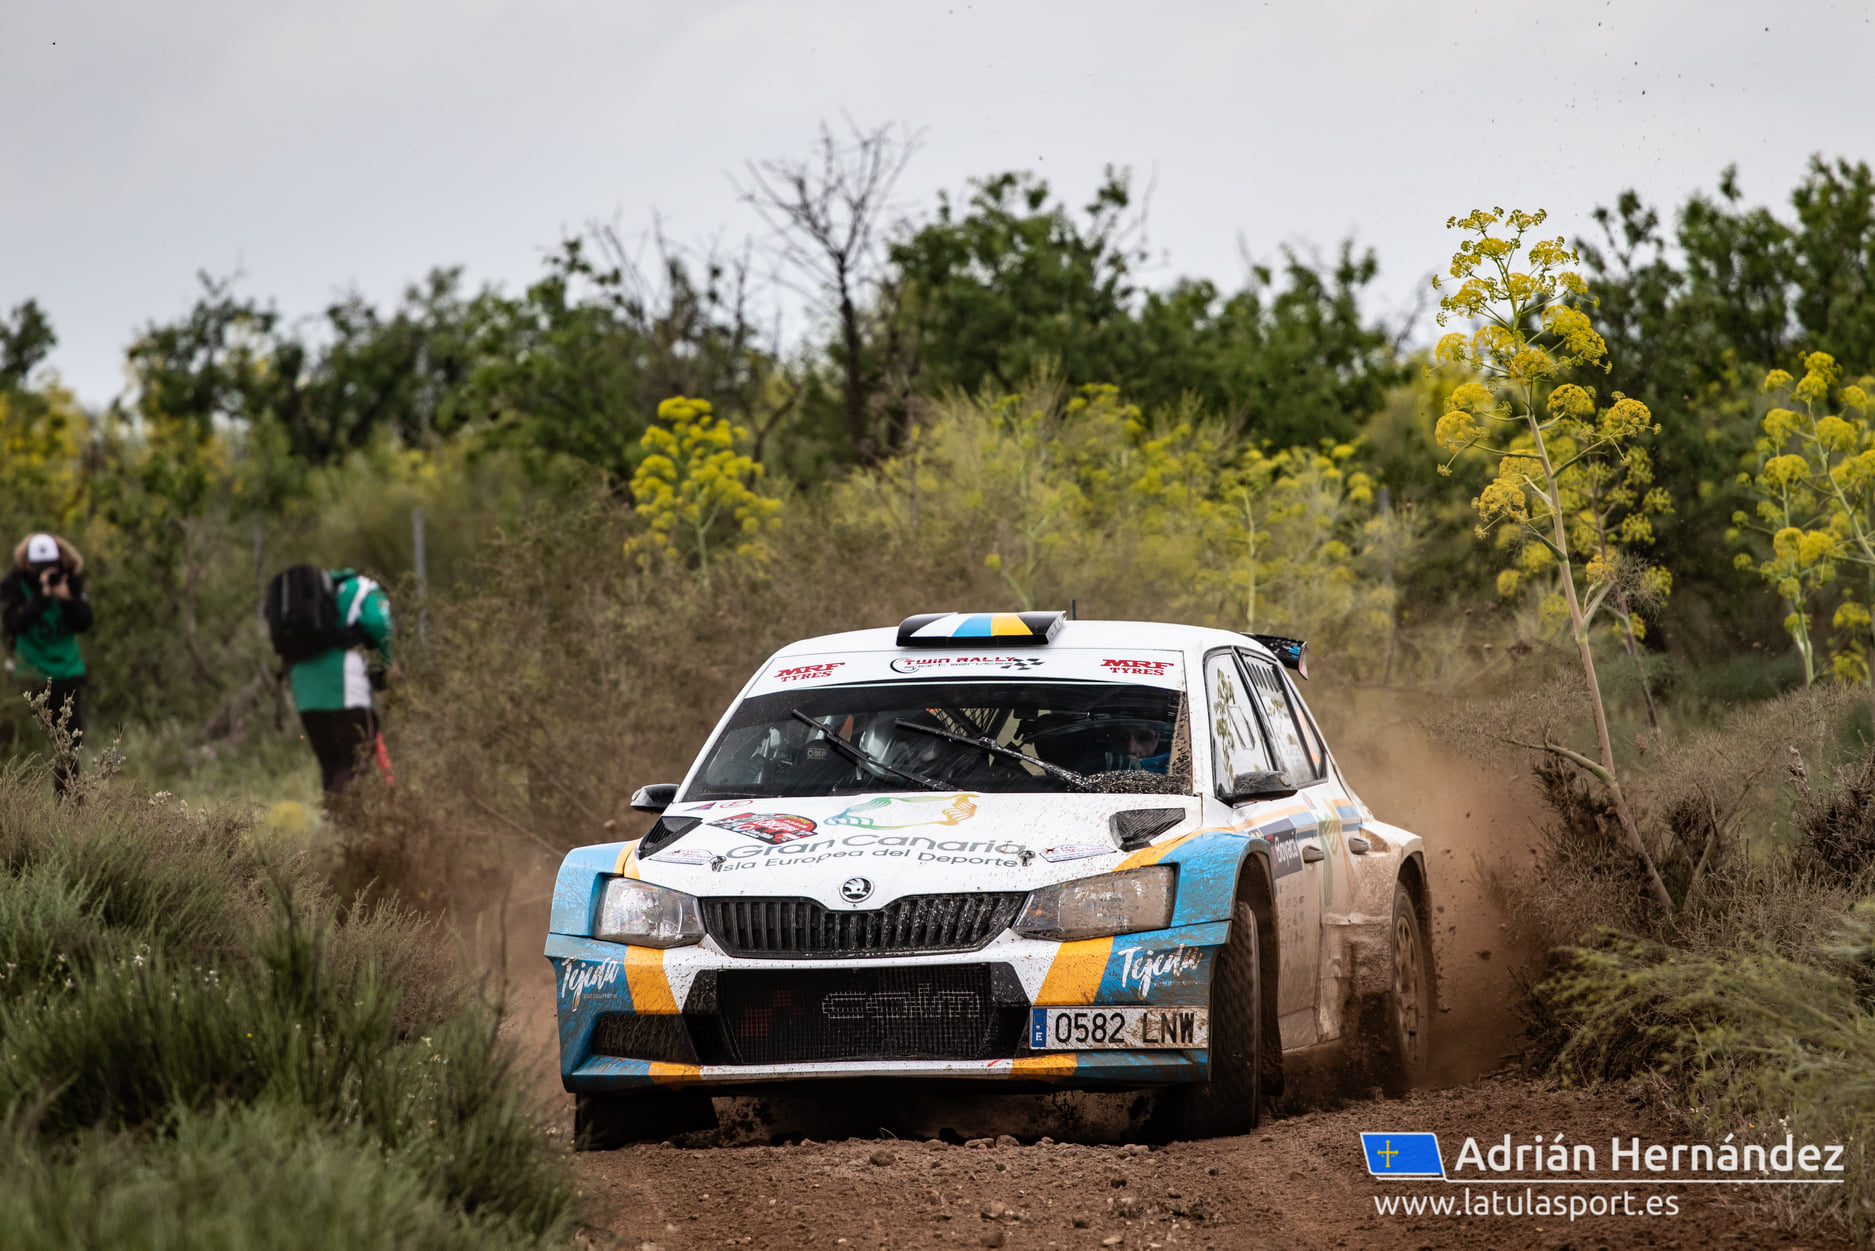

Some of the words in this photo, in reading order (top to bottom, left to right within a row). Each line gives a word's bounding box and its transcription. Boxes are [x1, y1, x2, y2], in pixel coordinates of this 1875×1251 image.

[774, 662, 845, 678] MRF
[1100, 659, 1174, 669] MRF
[781, 670, 832, 682] TYRES
[1110, 667, 1164, 676] TYRES
[726, 839, 836, 859] Gran
[841, 834, 1027, 855] Canaria
[717, 861, 756, 873] Isla
[765, 850, 864, 867] Europea
[872, 849, 910, 857] del
[917, 851, 1018, 868] Deporte
[1055, 1012, 1125, 1043] 0582
[1142, 1012, 1194, 1044] LNW
[1035, 1032, 1043, 1041] E
